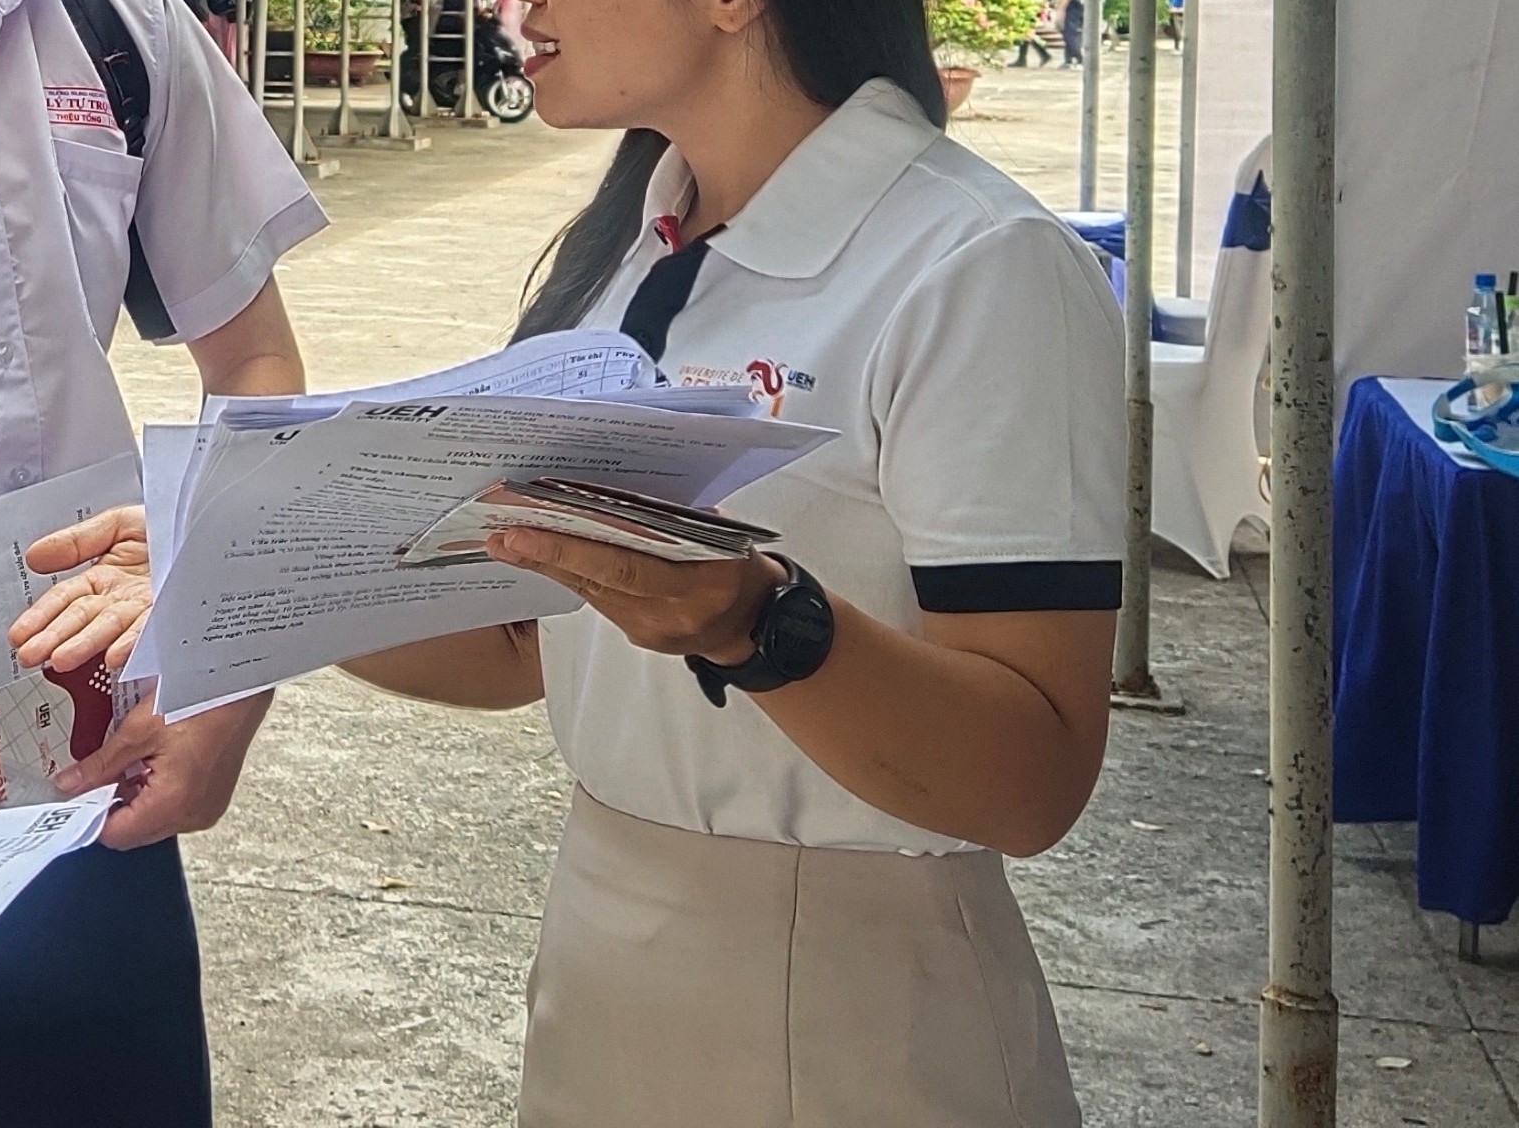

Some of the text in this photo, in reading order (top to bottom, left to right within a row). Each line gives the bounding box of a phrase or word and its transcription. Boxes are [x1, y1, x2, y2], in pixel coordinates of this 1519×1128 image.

[46, 96, 63, 108] LÝ
[67, 97, 85, 110] TỰ
[731, 371, 743, 383] DE
[787, 369, 816, 389] UEH
[364, 404, 449, 418] UEH
[38, 702, 51, 728] UEH
[36, 805, 82, 836] UEH
